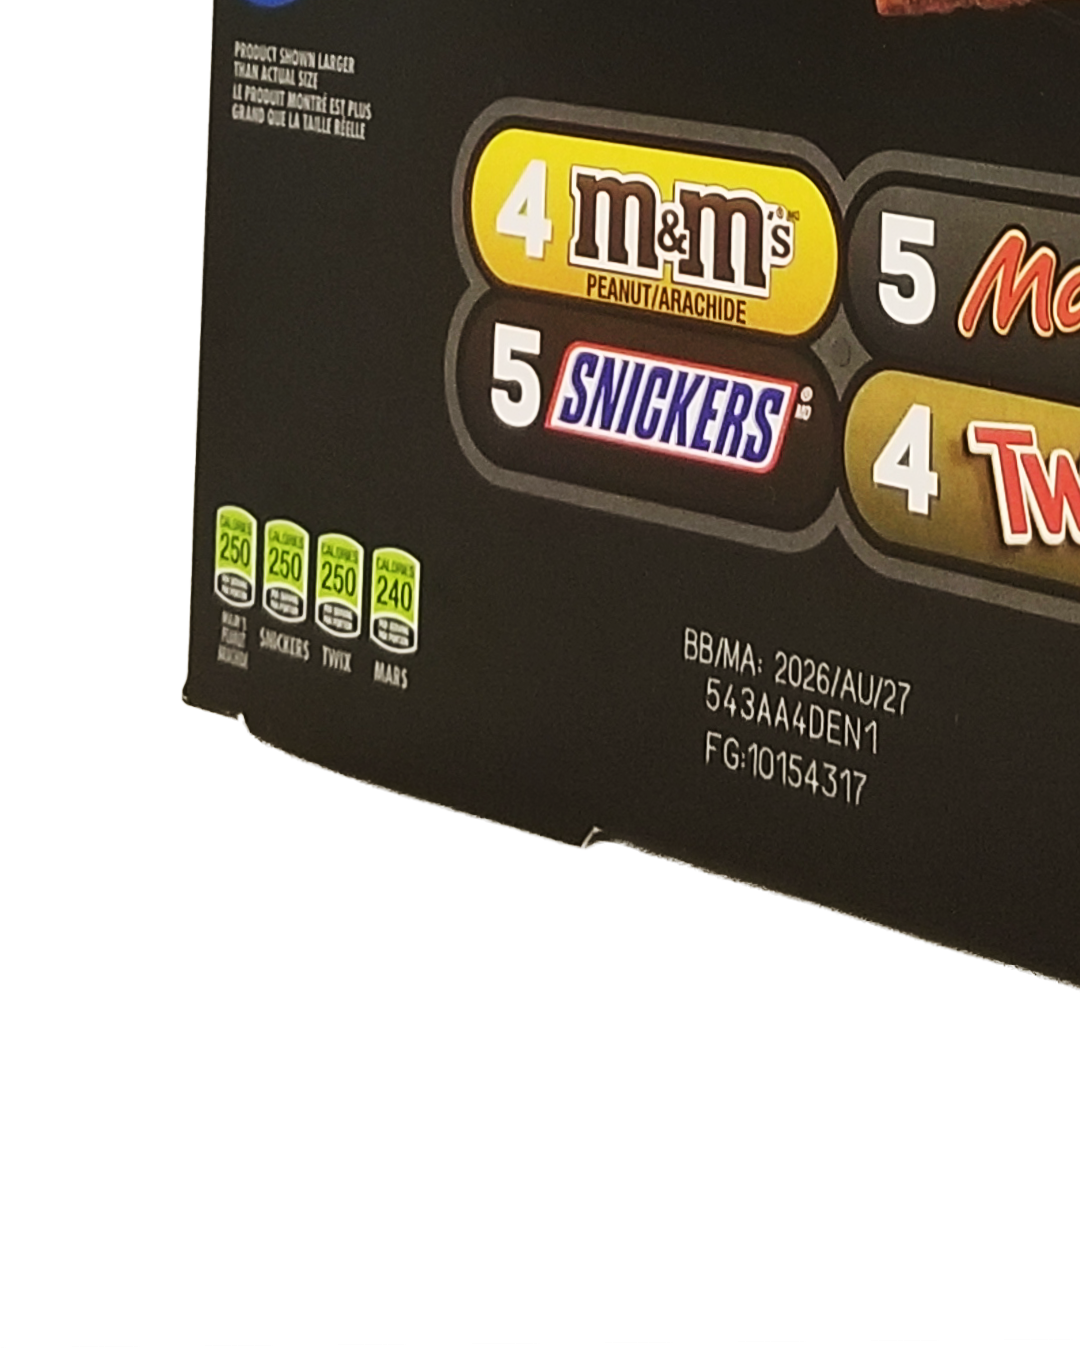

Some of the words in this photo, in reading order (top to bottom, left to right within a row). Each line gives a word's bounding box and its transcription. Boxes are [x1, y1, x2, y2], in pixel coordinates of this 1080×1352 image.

[234, 40, 277, 63] PRODUCT
[279, 47, 316, 69] SHOWN
[318, 51, 356, 74] LARGER
[234, 60, 259, 80] THAN
[261, 65, 296, 86] ACTUAL
[298, 70, 319, 90] SIZE
[231, 103, 265, 124] GRAND
[267, 108, 287, 128] QUE
[288, 111, 300, 129] LA
[303, 113, 332, 135] TAILLE
[232, 83, 242, 101] LE
[244, 85, 285, 107] PRODUIT
[287, 91, 328, 114] MONTRÉ
[329, 97, 346, 117] EST
[348, 99, 372, 121] PLUS
[496, 159, 552, 260] 4
[878, 213, 936, 326] 5
[587, 273, 747, 325] PEANUT/ARACHIDE
[490, 323, 543, 428] 5
[560, 350, 786, 465] SNICKERS
[873, 403, 938, 515] 4
[220, 532, 250, 567] 250
[269, 547, 303, 582] 250
[322, 561, 356, 597] 250
[376, 575, 413, 612] 240
[259, 626, 311, 661] SNICKERS
[322, 645, 352, 673] TWIX
[373, 660, 408, 690] MARS
[684, 627, 763, 677] BB/MA:
[774, 651, 911, 716] 2026/AU/27
[706, 677, 878, 755] 543AA4DEN1
[705, 730, 867, 806] FG:10154317
